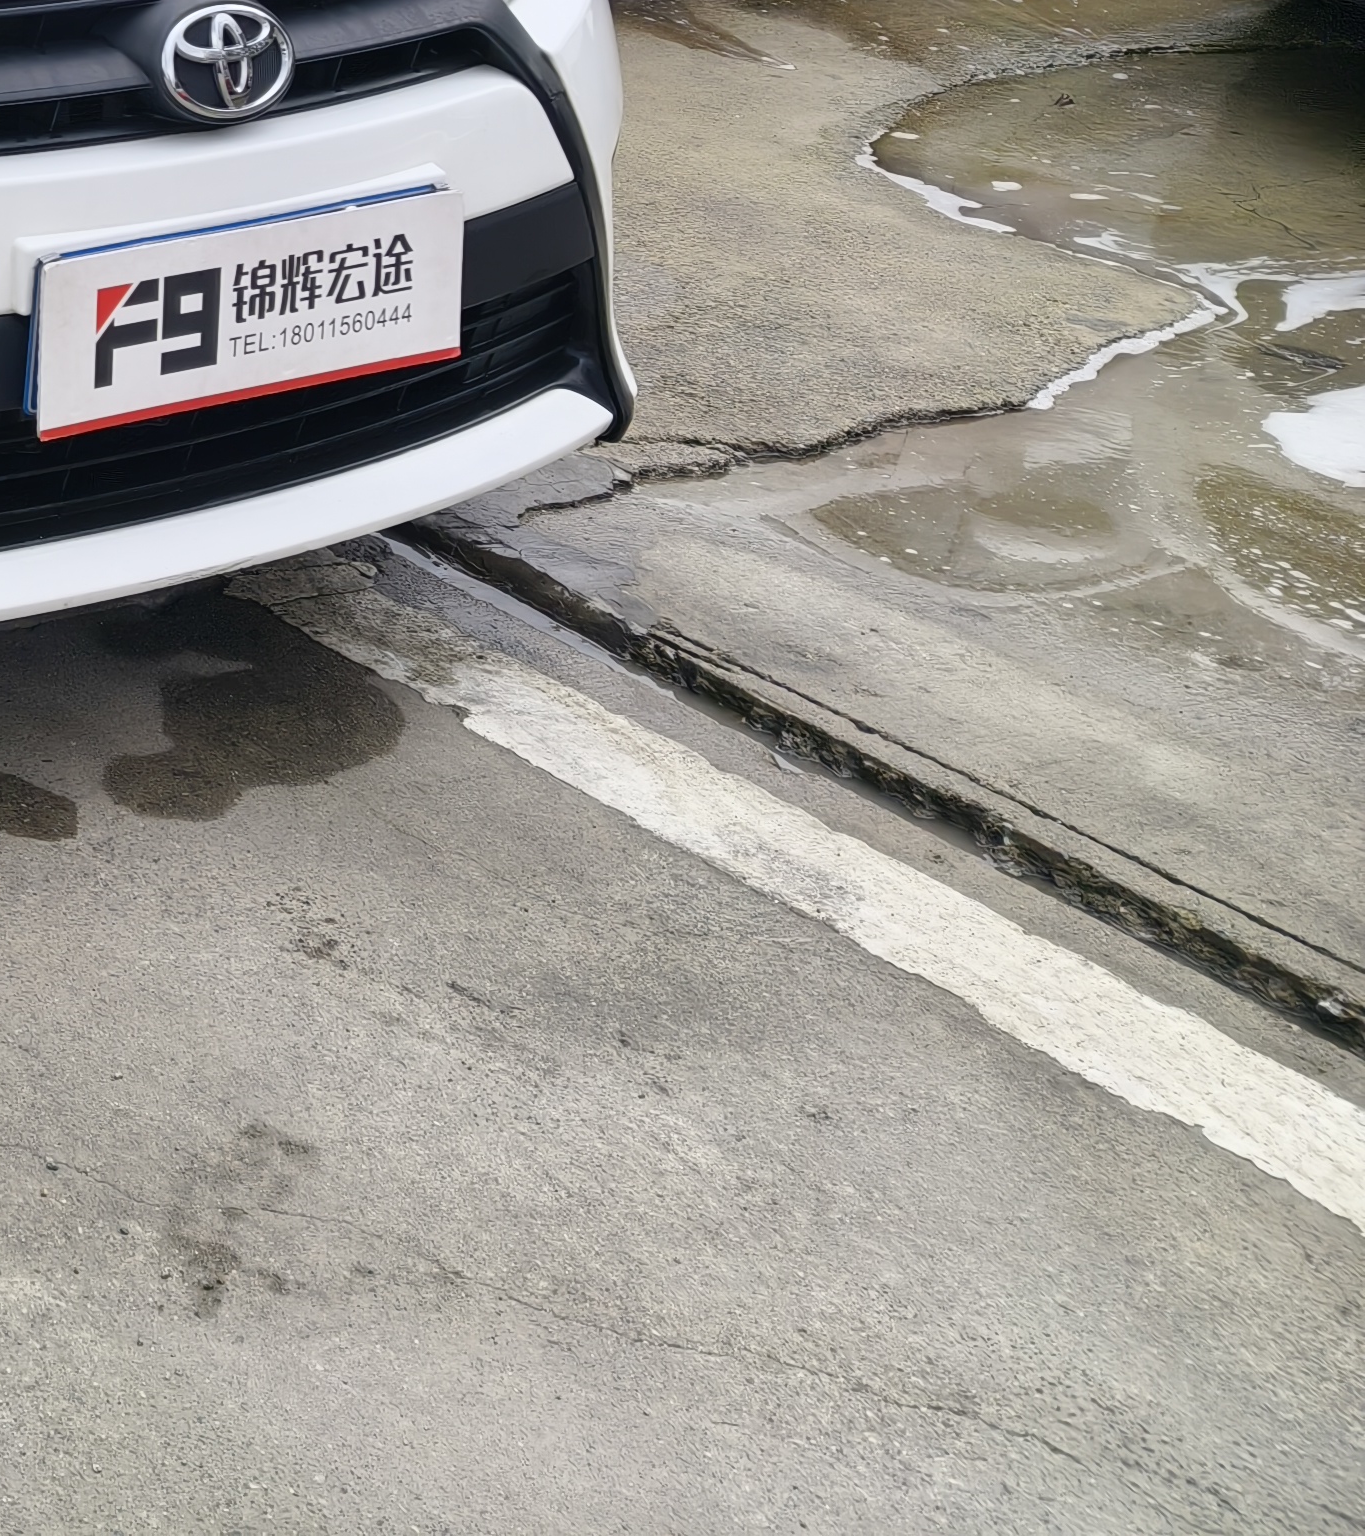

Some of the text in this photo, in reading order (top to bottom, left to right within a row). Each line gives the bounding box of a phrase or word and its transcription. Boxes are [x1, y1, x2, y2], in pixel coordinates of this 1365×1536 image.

[231, 233, 414, 325] 锦辉宏途
[229, 302, 413, 358] TEL:18011560444
